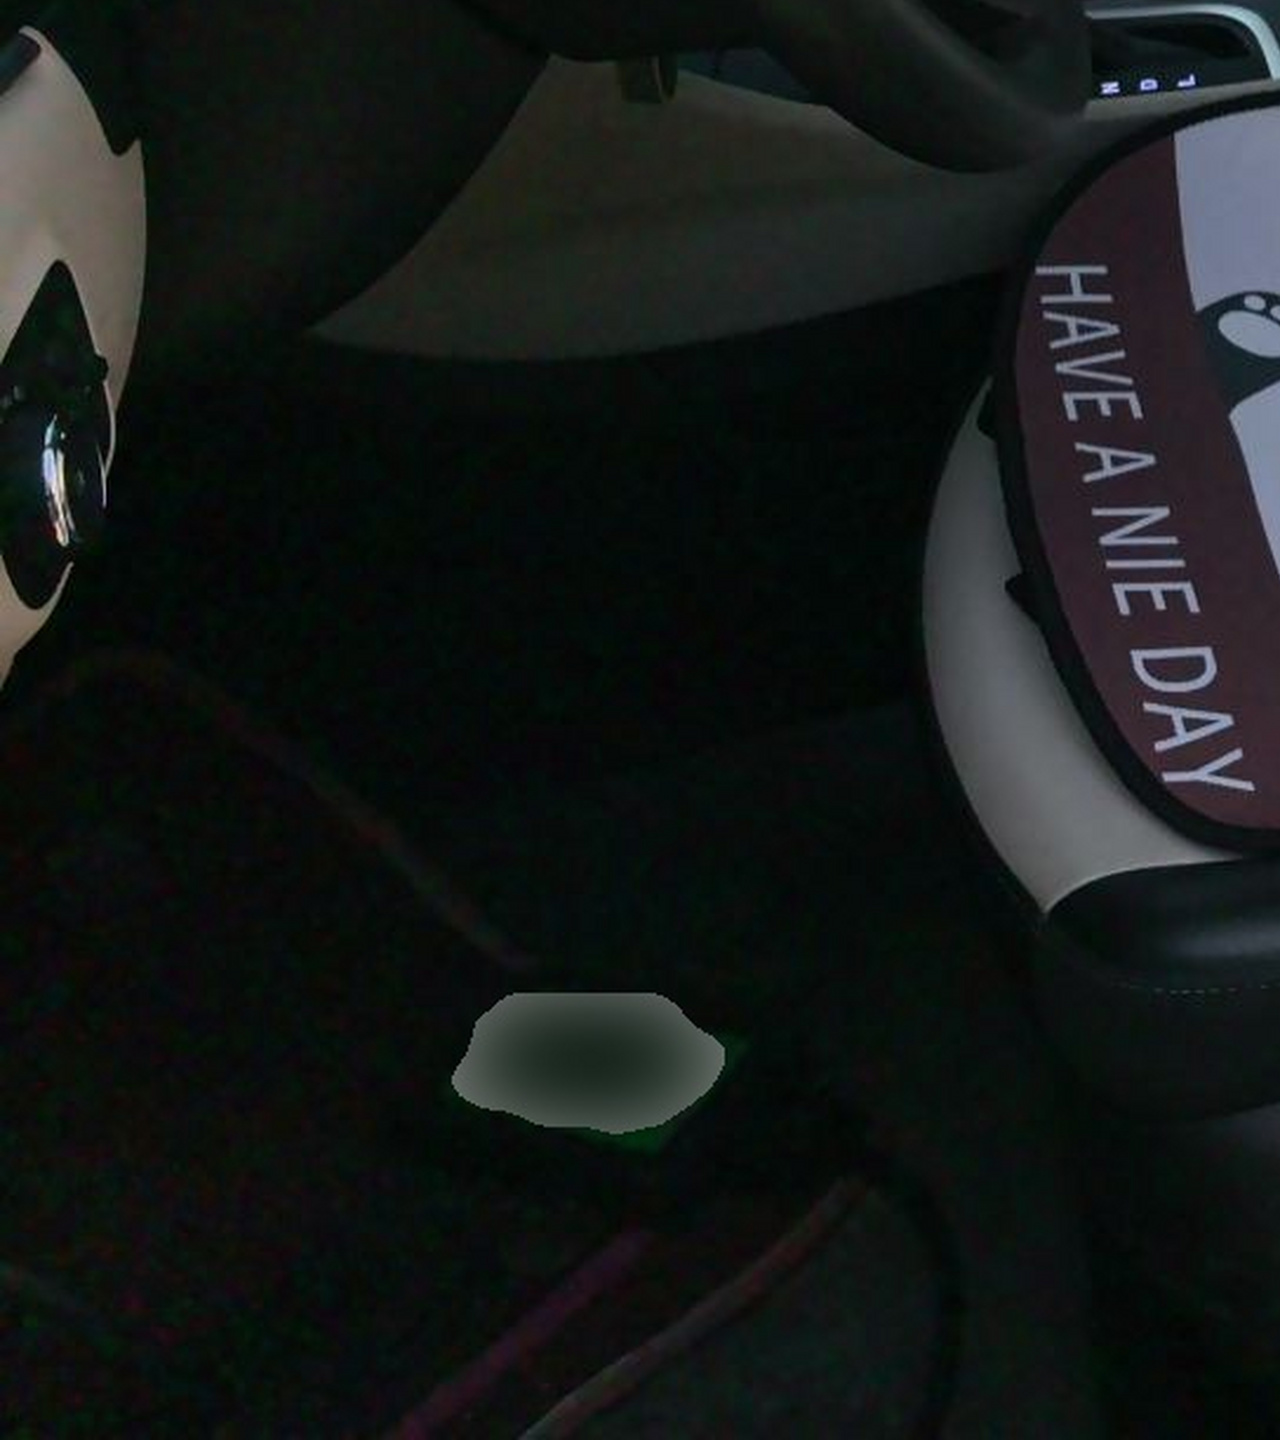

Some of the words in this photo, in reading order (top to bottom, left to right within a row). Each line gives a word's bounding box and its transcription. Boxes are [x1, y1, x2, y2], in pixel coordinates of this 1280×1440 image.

[1034, 264, 1145, 421] HAVE
[1074, 441, 1156, 484] A
[1091, 505, 1201, 615] NIE
[1130, 645, 1255, 792] DAY
